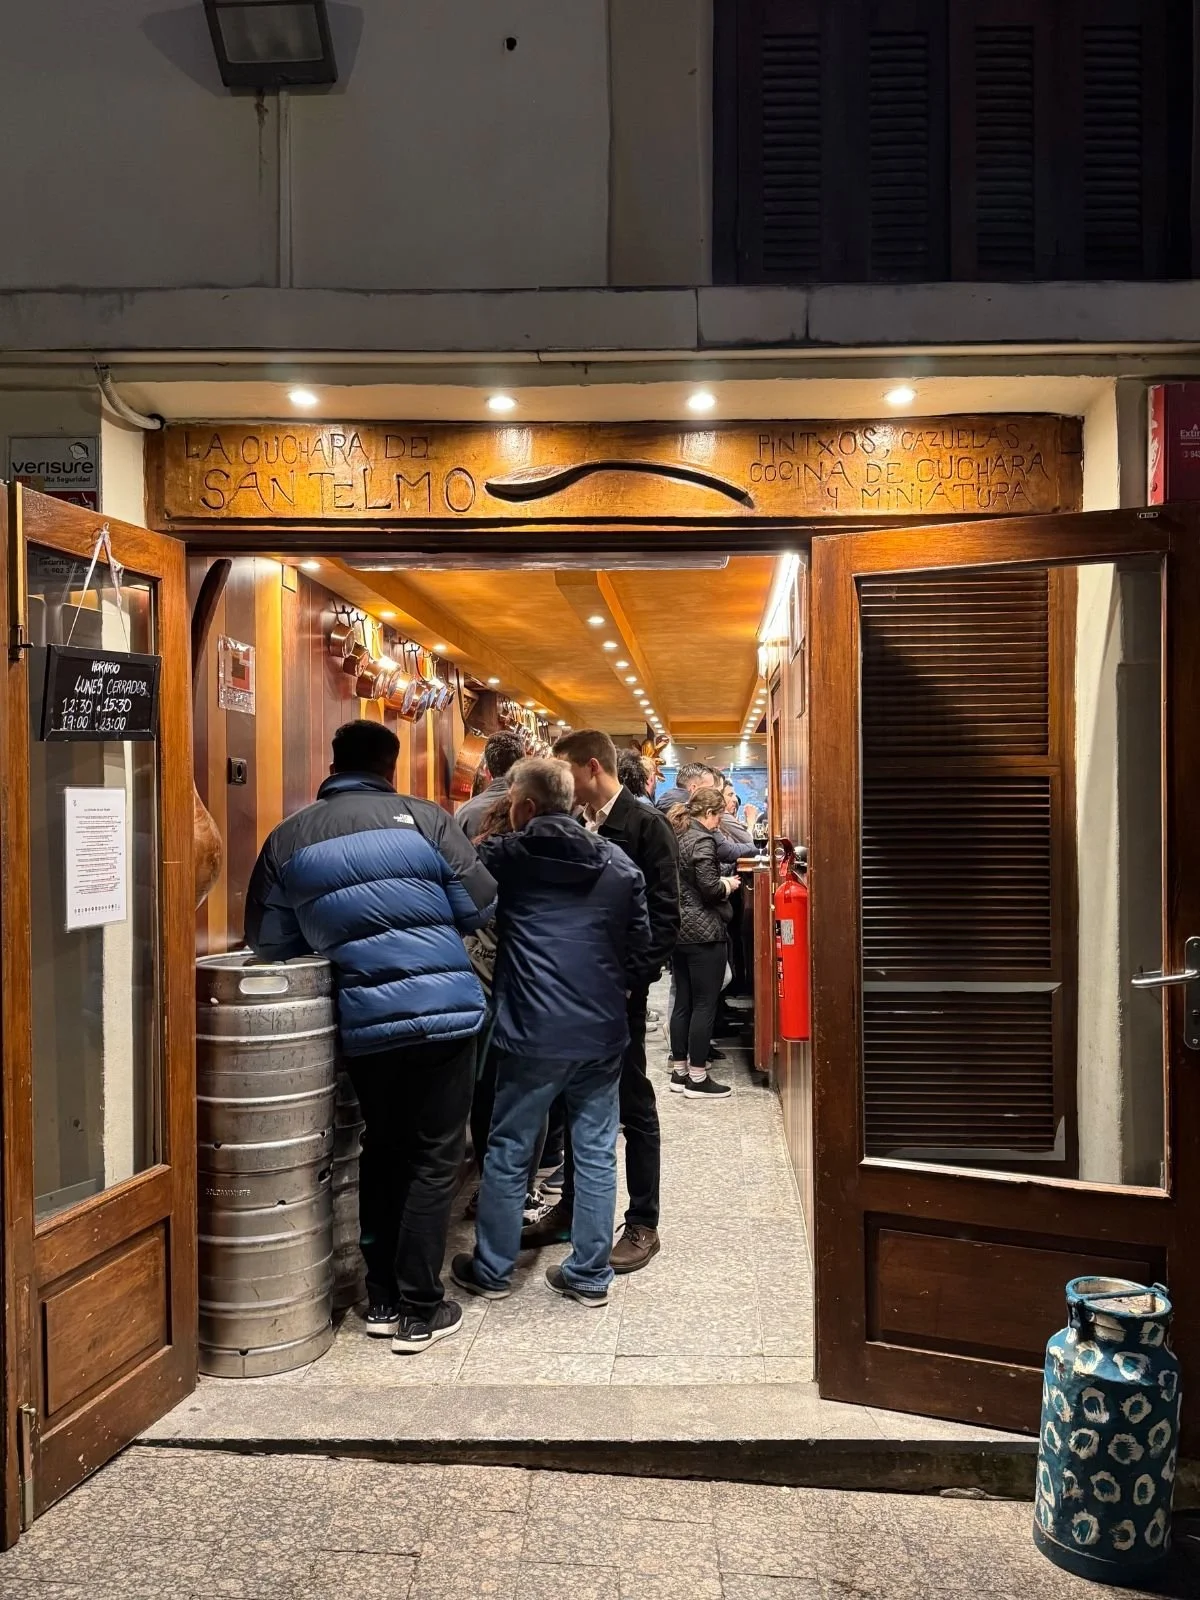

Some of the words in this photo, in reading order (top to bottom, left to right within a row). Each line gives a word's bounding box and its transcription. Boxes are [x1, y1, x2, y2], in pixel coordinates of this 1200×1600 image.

[183, 431, 233, 465] LA
[241, 431, 373, 467] CUCHARA
[385, 434, 429, 459] DE
[11, 461, 94, 475] verisure
[749, 460, 854, 489] COCINA
[866, 463, 904, 484] DE
[916, 452, 1050, 486] CUCHARA
[57, 475, 91, 484] Seguridad
[200, 468, 296, 513] SAN
[308, 467, 476, 513] TELMO
[91, 660, 121, 675] HORARIO
[74, 675, 103, 695] LUNES
[61, 698, 93, 714] 12:30
[102, 697, 132, 713] 15:30
[62, 715, 89, 730] 19:00
[100, 717, 127, 731] 23:00
